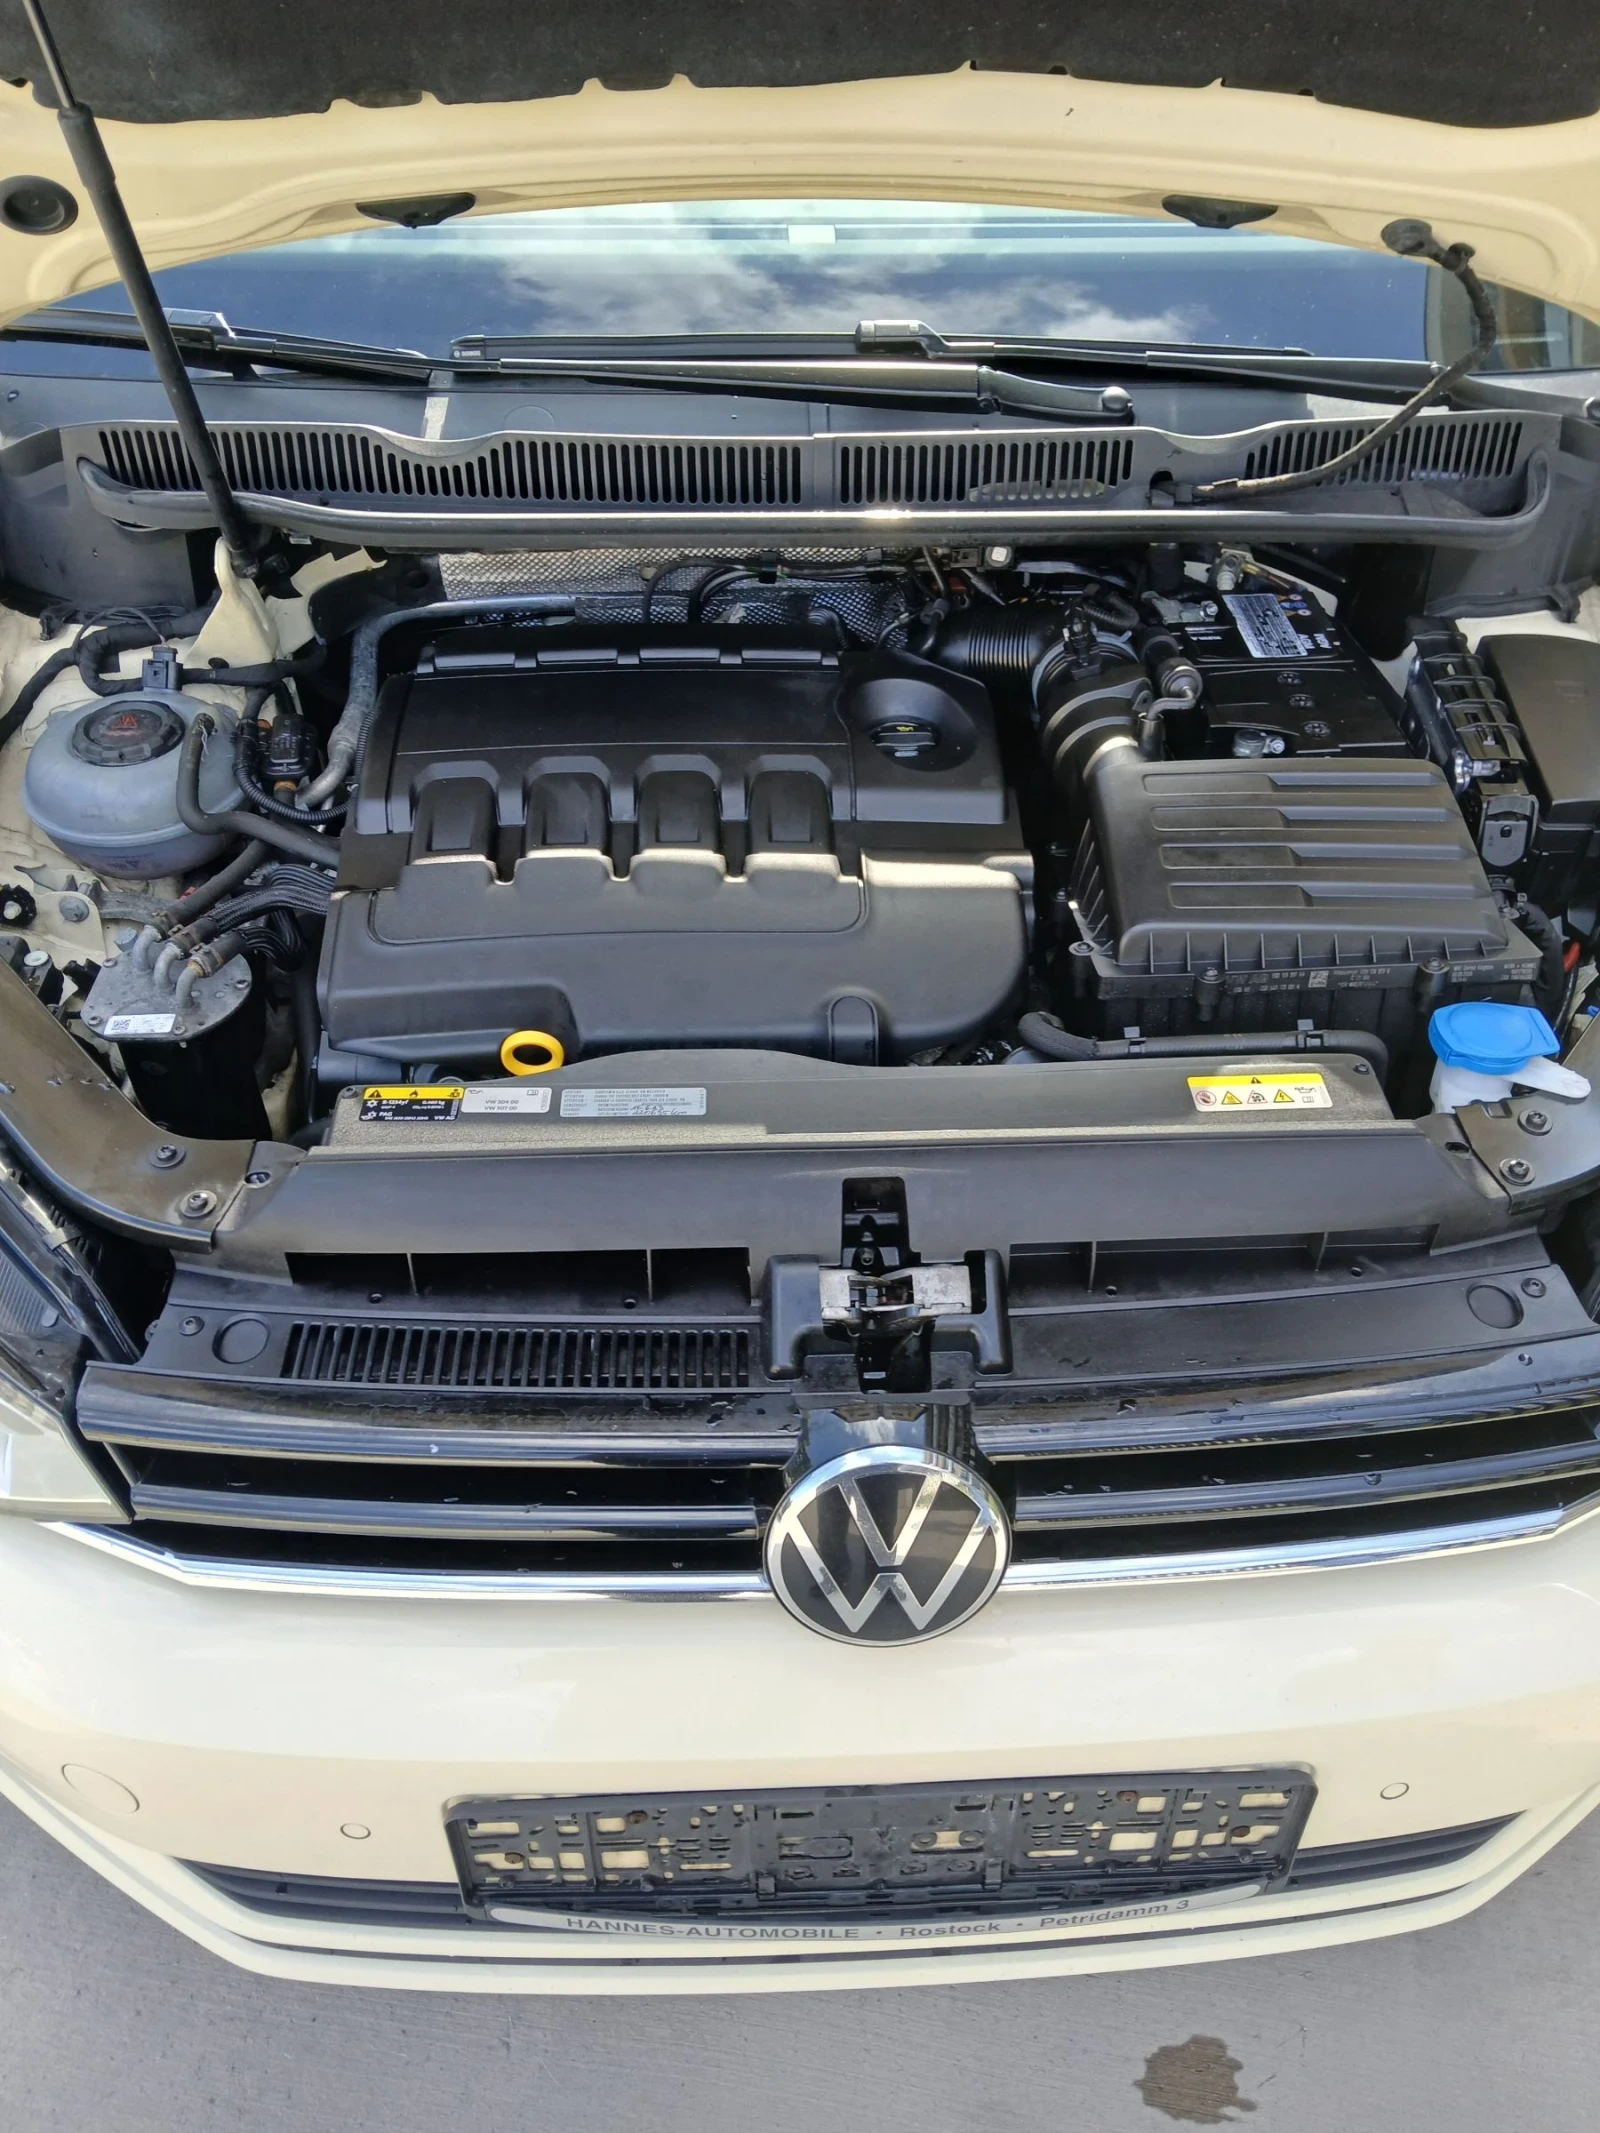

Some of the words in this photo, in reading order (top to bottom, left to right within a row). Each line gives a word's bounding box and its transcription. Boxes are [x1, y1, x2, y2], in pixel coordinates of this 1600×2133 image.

[772, 1454, 1004, 1640] VW
[566, 1917, 860, 1939] HANNES-AUTOMOBILE
[899, 1921, 1001, 1938] Rostock
[1039, 1902, 1169, 1928] Petridamm
[1175, 1899, 1190, 1910] 3
